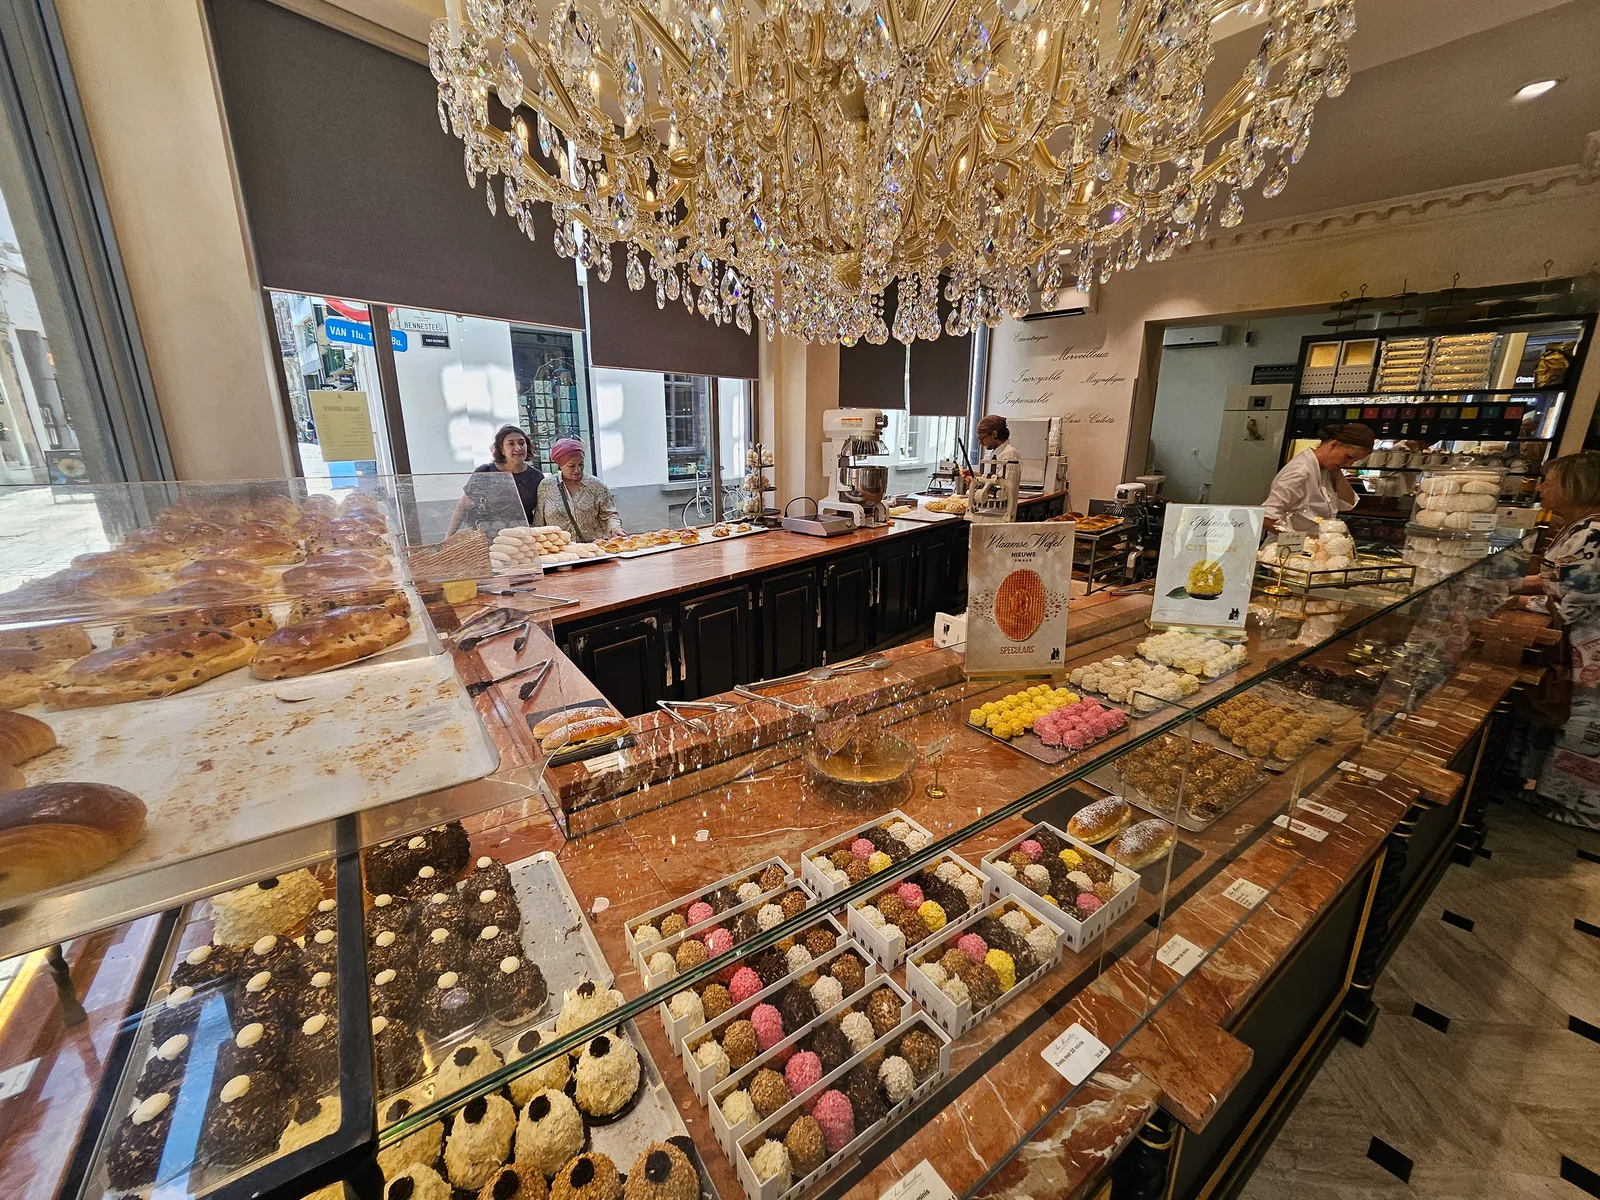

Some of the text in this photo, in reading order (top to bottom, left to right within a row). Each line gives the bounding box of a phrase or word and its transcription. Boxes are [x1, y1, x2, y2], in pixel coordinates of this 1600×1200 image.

[404, 321, 444, 331] BENNESTEEG
[329, 325, 347, 337] VAN
[351, 329, 366, 340] 11u.
[391, 337, 403, 347] 8u.
[1052, 346, 1110, 361] Merveilleux
[1012, 369, 1065, 386] Incroyable
[1080, 372, 1126, 386] Magnifique
[998, 391, 1053, 407] Impensable
[1196, 527, 1226, 538] Mini
[985, 531, 1066, 552] Vlaamse Wafel
[1000, 645, 1035, 655] SPECULAAS
[1075, 1040, 1084, 1049] minis
